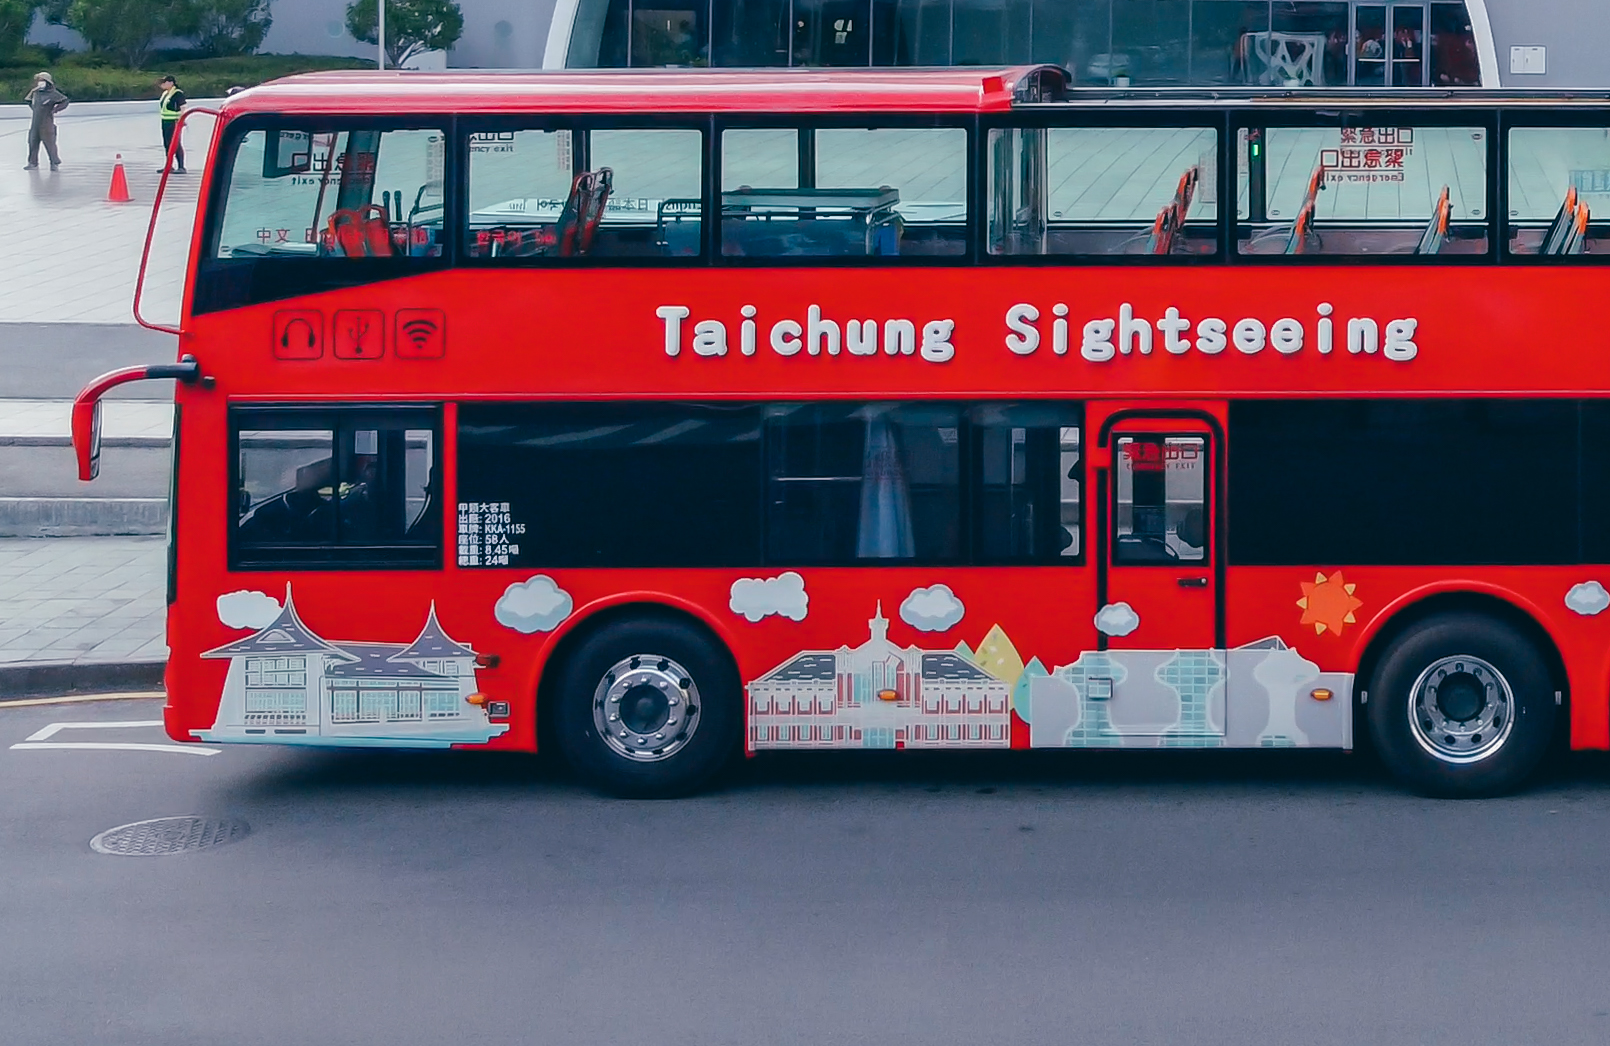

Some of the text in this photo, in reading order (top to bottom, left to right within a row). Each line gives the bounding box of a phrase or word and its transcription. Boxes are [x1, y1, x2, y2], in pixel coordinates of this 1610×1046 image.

[256, 227, 290, 243] 中文
[656, 303, 1418, 362] Taichung Sightseeing
[485, 513, 511, 523] 2016
[485, 523, 526, 534] KKA-1155
